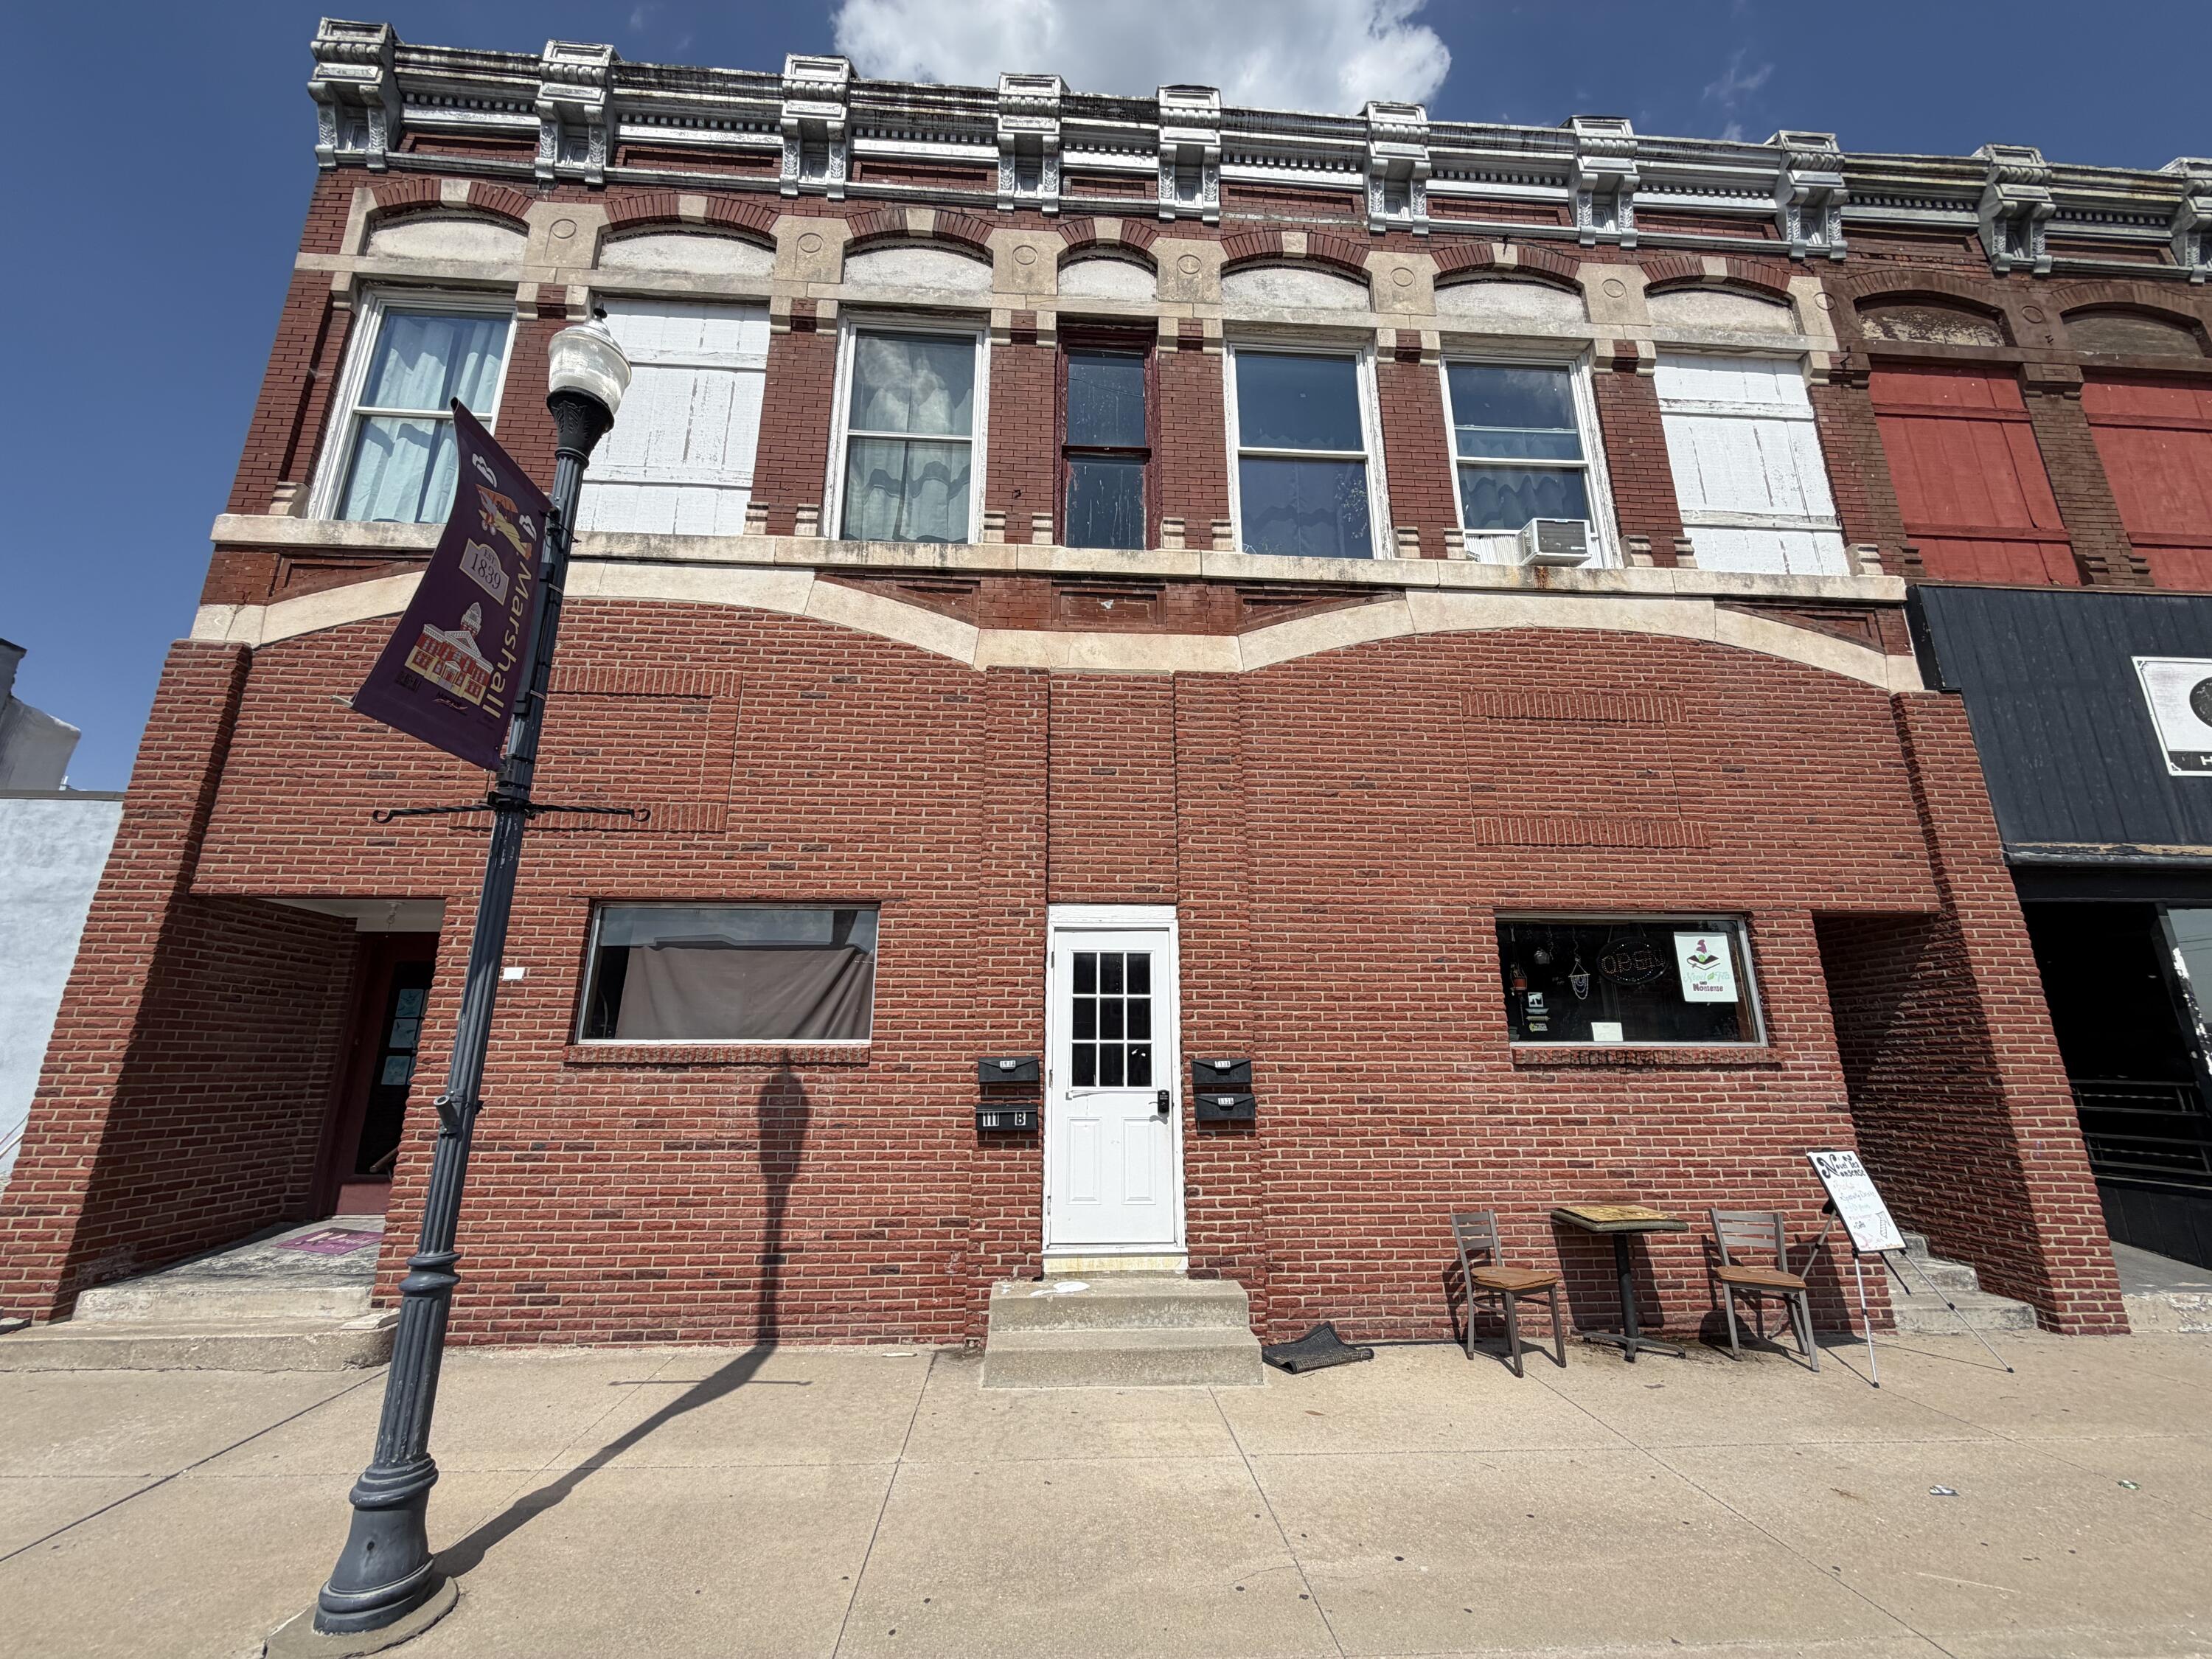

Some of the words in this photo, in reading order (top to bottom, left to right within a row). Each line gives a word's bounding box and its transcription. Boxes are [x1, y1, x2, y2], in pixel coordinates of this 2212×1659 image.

[483, 548, 497, 567] EST.
[470, 552, 501, 590] 1839
[481, 560, 532, 719] Marshall
[1601, 948, 1665, 974] OPEN
[1016, 1112, 1025, 1125] B
